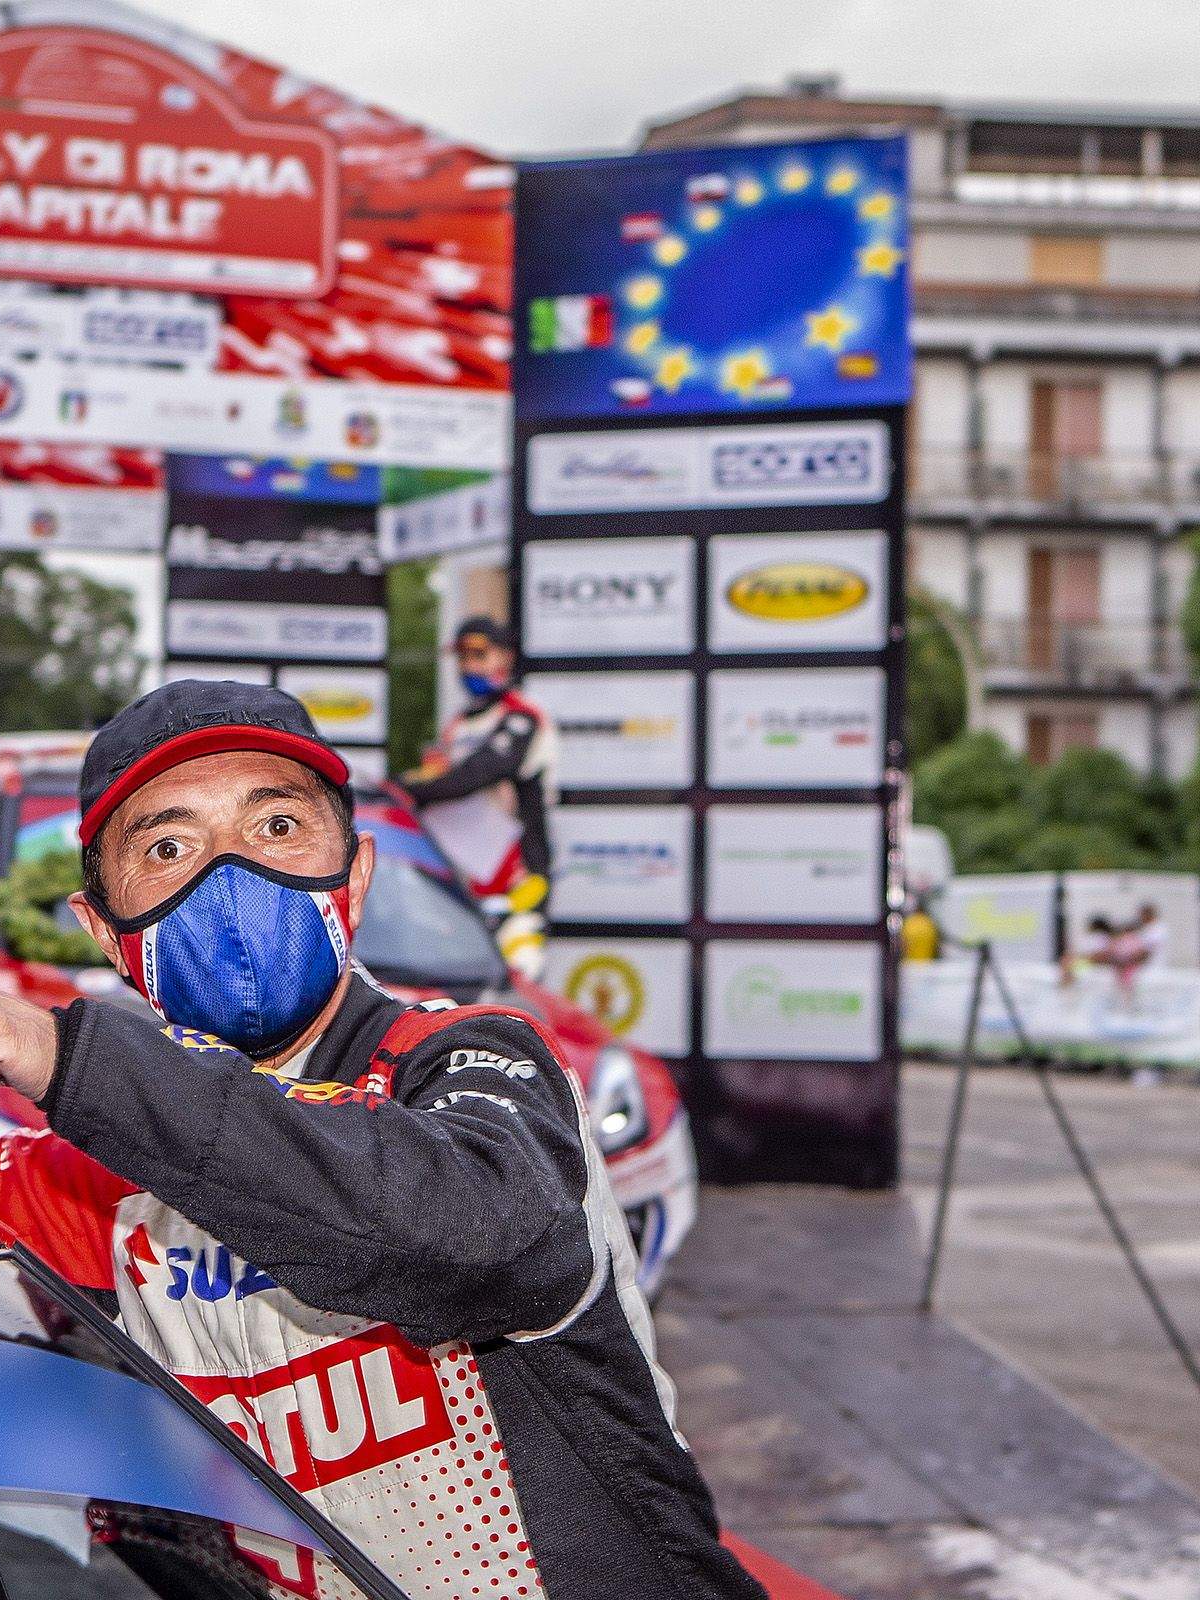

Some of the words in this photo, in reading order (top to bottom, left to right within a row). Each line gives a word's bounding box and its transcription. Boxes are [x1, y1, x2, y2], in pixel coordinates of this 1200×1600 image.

[63, 138, 125, 184] DI
[136, 144, 313, 199] ROMA
[537, 573, 675, 605] SONY
[205, 1346, 426, 1478] OTUL
